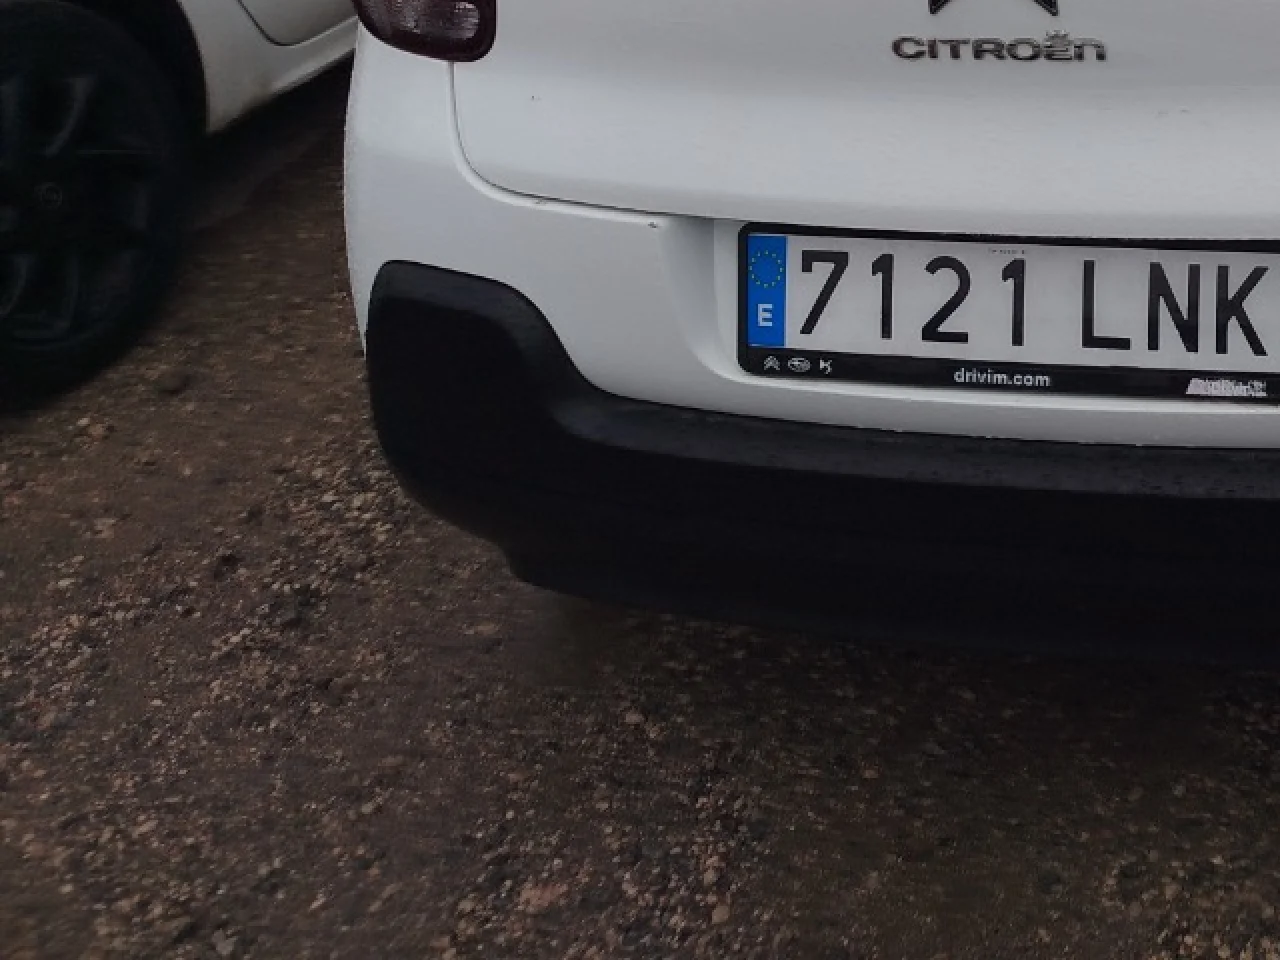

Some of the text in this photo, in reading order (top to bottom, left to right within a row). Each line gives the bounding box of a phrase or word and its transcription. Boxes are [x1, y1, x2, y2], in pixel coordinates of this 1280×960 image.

[757, 303, 773, 327] E
[800, 249, 1270, 357] 7121 LNK
[953, 367, 1051, 387] drivim.com
